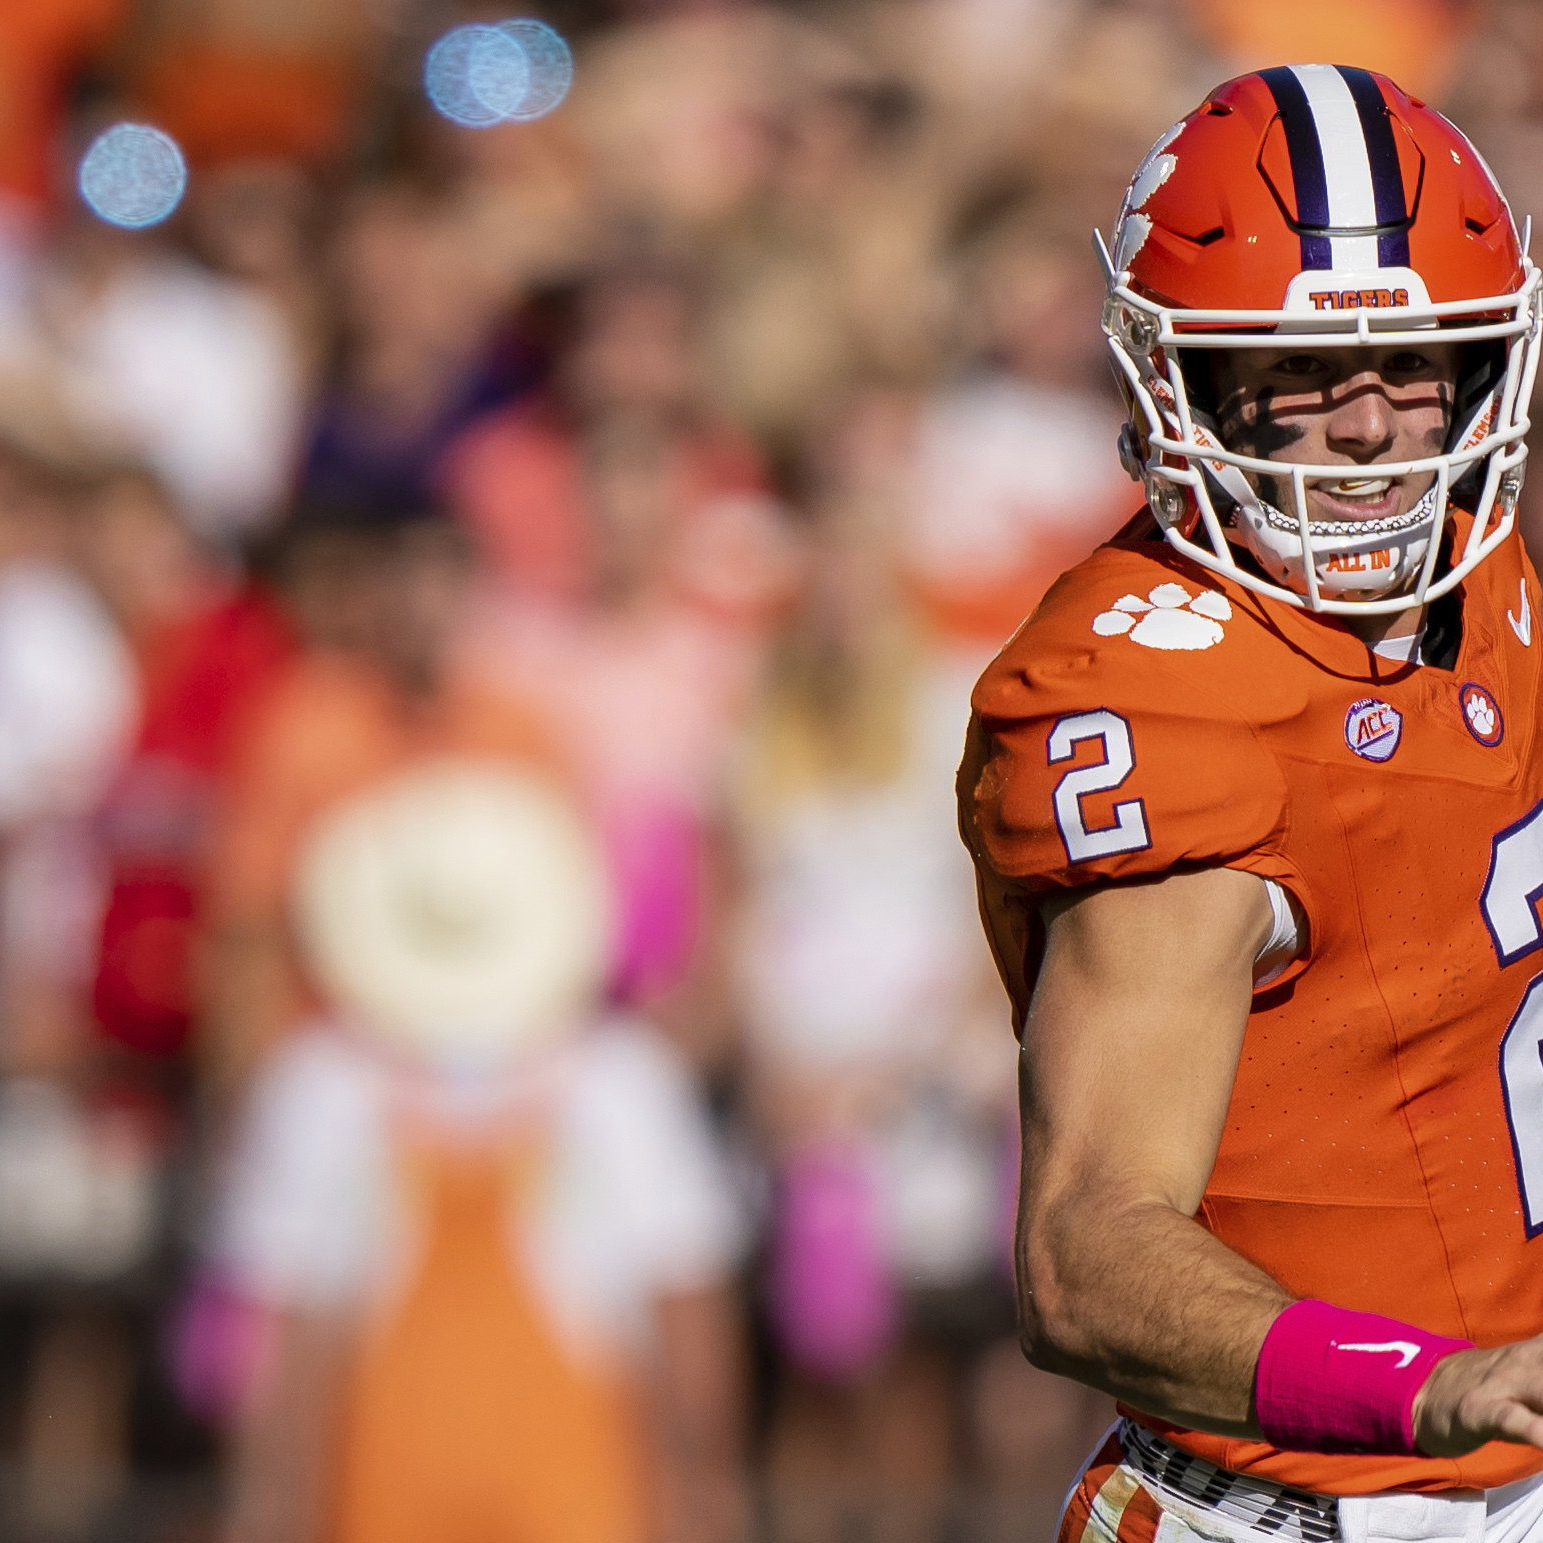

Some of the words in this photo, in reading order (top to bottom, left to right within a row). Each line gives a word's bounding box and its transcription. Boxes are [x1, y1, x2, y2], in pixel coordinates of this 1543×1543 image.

[1309, 289, 1409, 310] TIGERS
[1325, 553, 1366, 572] ALL
[1369, 548, 1391, 570] IN
[1356, 706, 1393, 746] ACC
[1047, 708, 1152, 864] 2
